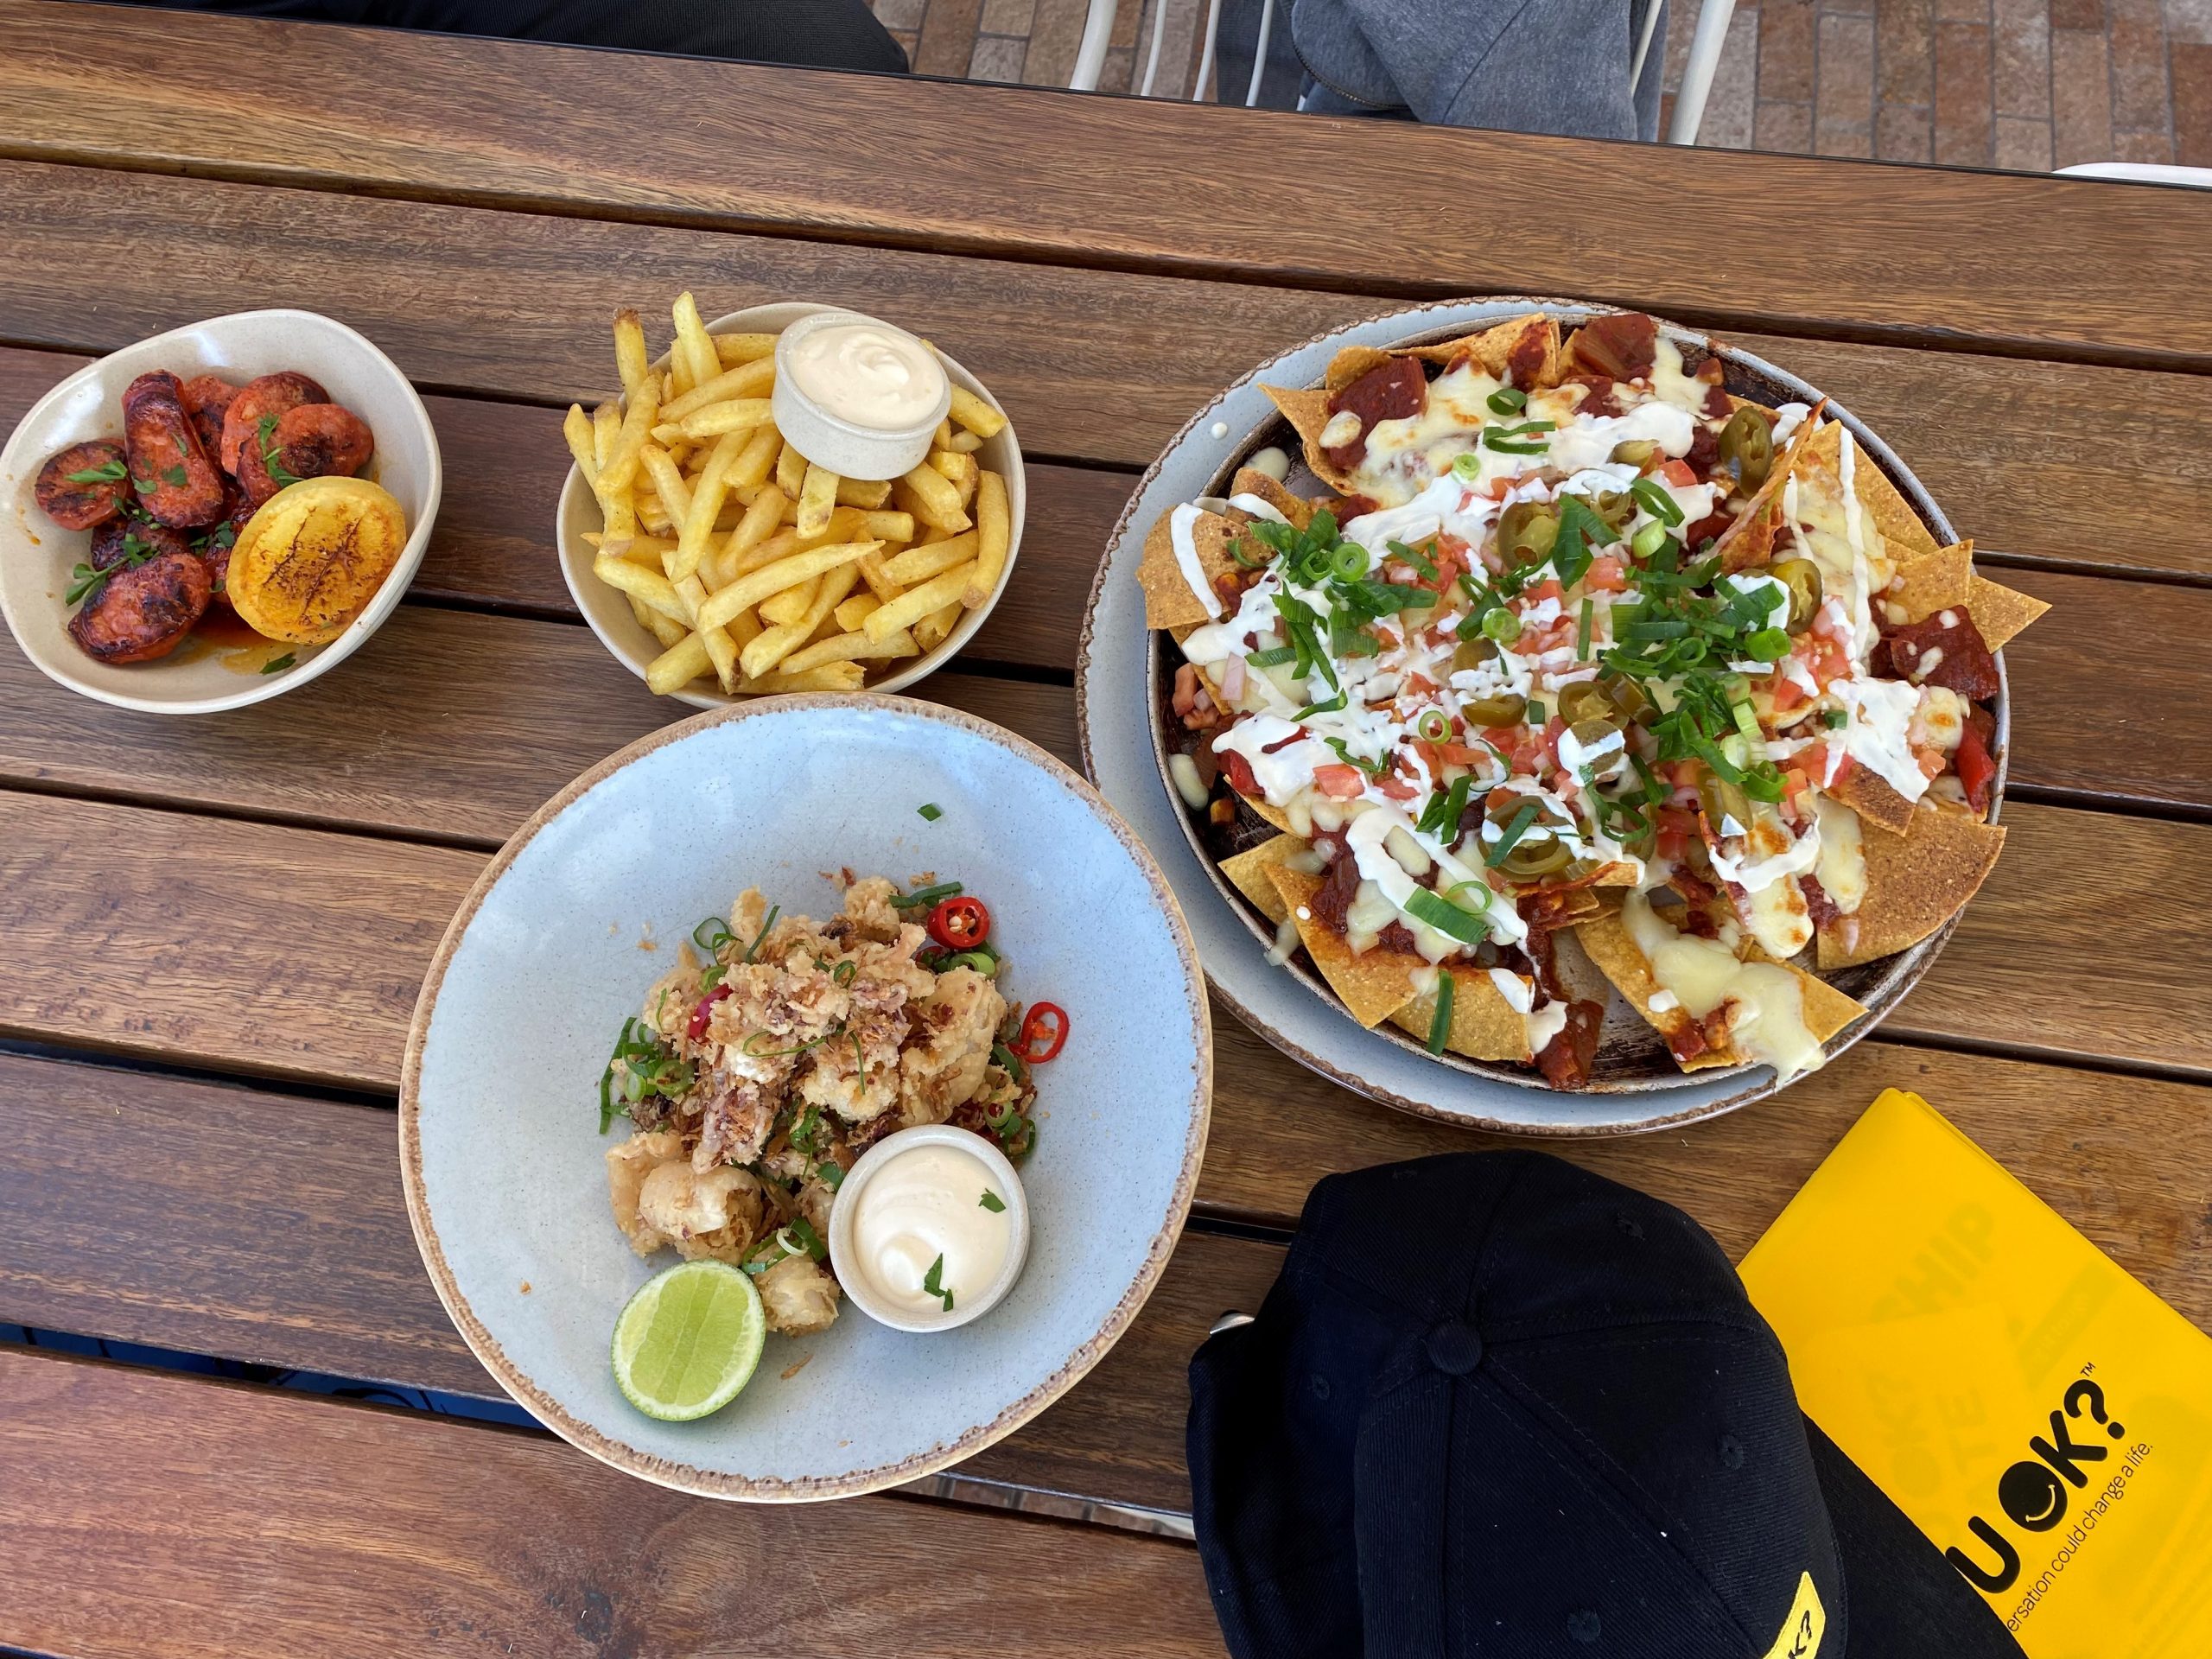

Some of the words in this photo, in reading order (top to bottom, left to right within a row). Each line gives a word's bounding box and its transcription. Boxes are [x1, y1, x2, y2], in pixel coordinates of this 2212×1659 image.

[2121, 1462, 2134, 1478] a
[2126, 1442, 2154, 1467] life.
[2082, 1476, 2126, 1530] change
[1945, 1516, 2020, 1594] U
[2051, 1525, 2087, 1573] could
